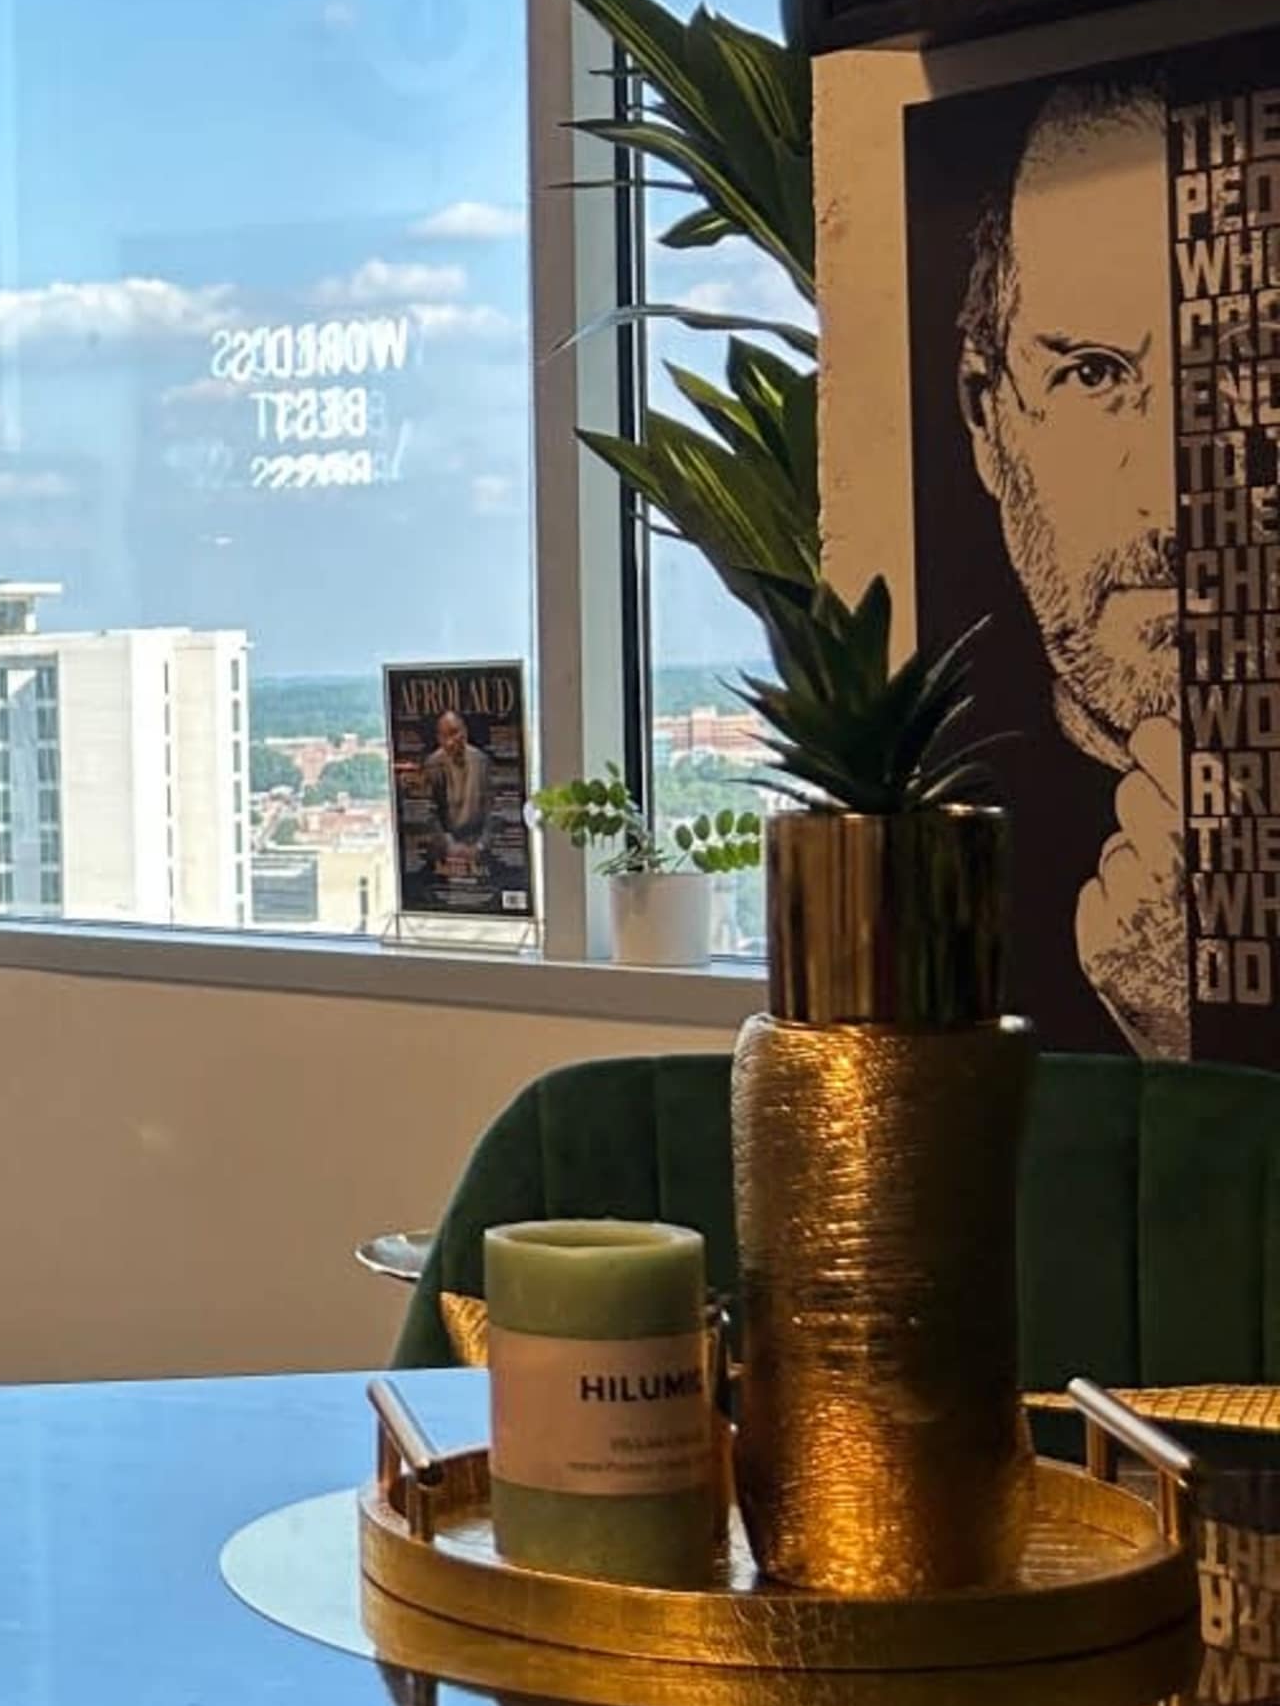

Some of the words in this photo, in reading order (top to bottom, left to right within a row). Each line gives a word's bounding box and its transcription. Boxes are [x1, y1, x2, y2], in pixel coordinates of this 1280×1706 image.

[1178, 430, 1247, 494] TO
[1179, 486, 1280, 550] THE
[1189, 814, 1280, 873] THE
[1195, 938, 1272, 1004] DO
